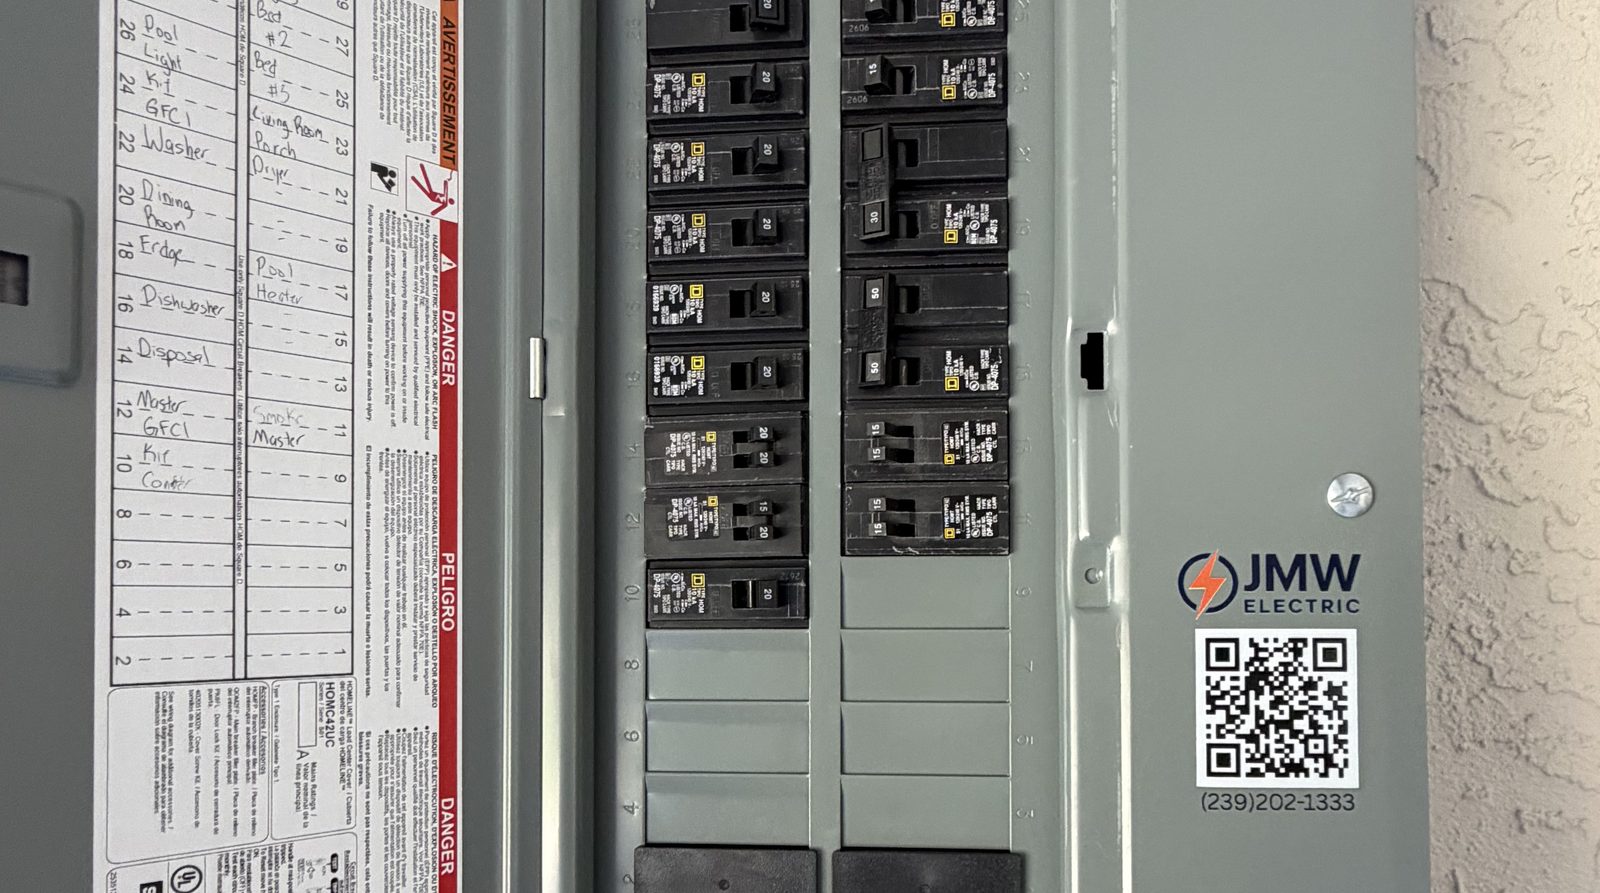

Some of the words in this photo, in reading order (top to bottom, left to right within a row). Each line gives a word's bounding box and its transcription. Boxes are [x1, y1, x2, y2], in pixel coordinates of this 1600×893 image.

[336, 0, 349, 10] 9
[987, 0, 996, 25] DP-4075
[119, 18, 136, 41] 26
[144, 14, 178, 41] Pool
[848, 24, 870, 33] 2606
[265, 30, 292, 48] #2
[336, 36, 349, 57] 27
[145, 43, 181, 76] Light
[254, 50, 276, 78] Bed
[762, 71, 771, 83] 20
[868, 63, 877, 75] 15
[119, 73, 136, 95] 24
[442, 16, 456, 165] AVERTISSEMENT
[653, 74, 662, 99] DP-4075
[987, 72, 997, 98] DP-4075
[335, 89, 349, 109] 25
[847, 95, 869, 104] 2606
[252, 105, 291, 139] Living
[294, 115, 323, 138] Room
[118, 131, 135, 153] 22
[142, 124, 209, 159] Washer
[255, 130, 296, 160] Porch
[335, 137, 348, 157] 23
[763, 143, 772, 156] 20
[653, 143, 661, 168] DP-4075
[117, 184, 134, 206] 20
[142, 179, 193, 219] Dining
[335, 188, 348, 205] 21
[144, 205, 186, 231] Room
[762, 218, 772, 230] 20
[870, 211, 879, 224] 30
[653, 215, 662, 240] DP-4075
[989, 219, 998, 244] DP-4075
[117, 241, 134, 260] 18
[334, 238, 348, 253] 19
[256, 255, 293, 278] Pool
[432, 264, 438, 273] OF
[143, 283, 226, 315] Dishwasher
[334, 284, 348, 301] 17
[761, 291, 771, 303] 20
[871, 287, 880, 299] 50
[117, 295, 133, 313] 16
[334, 330, 347, 347] 15
[117, 347, 133, 363] 14
[138, 336, 209, 367] Disposal
[442, 309, 456, 386] DANGER
[763, 366, 772, 378] 20
[871, 362, 879, 374] 50
[334, 376, 347, 393] 13
[432, 379, 438, 390] OR
[990, 364, 999, 391] DP-4075
[116, 400, 132, 418] 12
[137, 389, 187, 412] Master
[334, 424, 346, 438] 11
[759, 426, 768, 439] 20
[872, 424, 880, 435] 15
[252, 429, 305, 448] Master
[669, 433, 677, 458] DP-4075
[759, 452, 768, 464] 20
[872, 448, 881, 460] 15
[116, 455, 132, 473] 10
[335, 474, 346, 483] 9
[432, 486, 438, 495] DE
[671, 498, 679, 523] DP-4075
[759, 501, 768, 512] 15
[873, 498, 882, 510] 15
[116, 509, 132, 518] 8
[625, 512, 641, 530] 12
[335, 519, 347, 528] 7
[874, 523, 883, 535] 15
[986, 511, 994, 537] DP-4075
[759, 526, 768, 539] 20
[116, 559, 132, 569] 6
[334, 563, 346, 572] 5
[1244, 553, 1361, 592] JMW
[441, 552, 455, 632] PELIGRO
[624, 584, 641, 602] 10
[653, 573, 661, 598] DP-4075
[763, 588, 773, 600] 20
[116, 607, 131, 618] 4
[334, 606, 346, 614] 3
[1244, 599, 1360, 613] ELECTRIC
[115, 655, 131, 666] 2
[624, 659, 641, 671] 8
[325, 681, 336, 749] HOMC42UC
[623, 730, 641, 743] 6
[296, 749, 310, 761] A
[623, 801, 640, 816] 4
[1201, 792, 1355, 814] (239)202-1333
[441, 797, 455, 875] DANGER
[432, 874, 438, 884] OU
